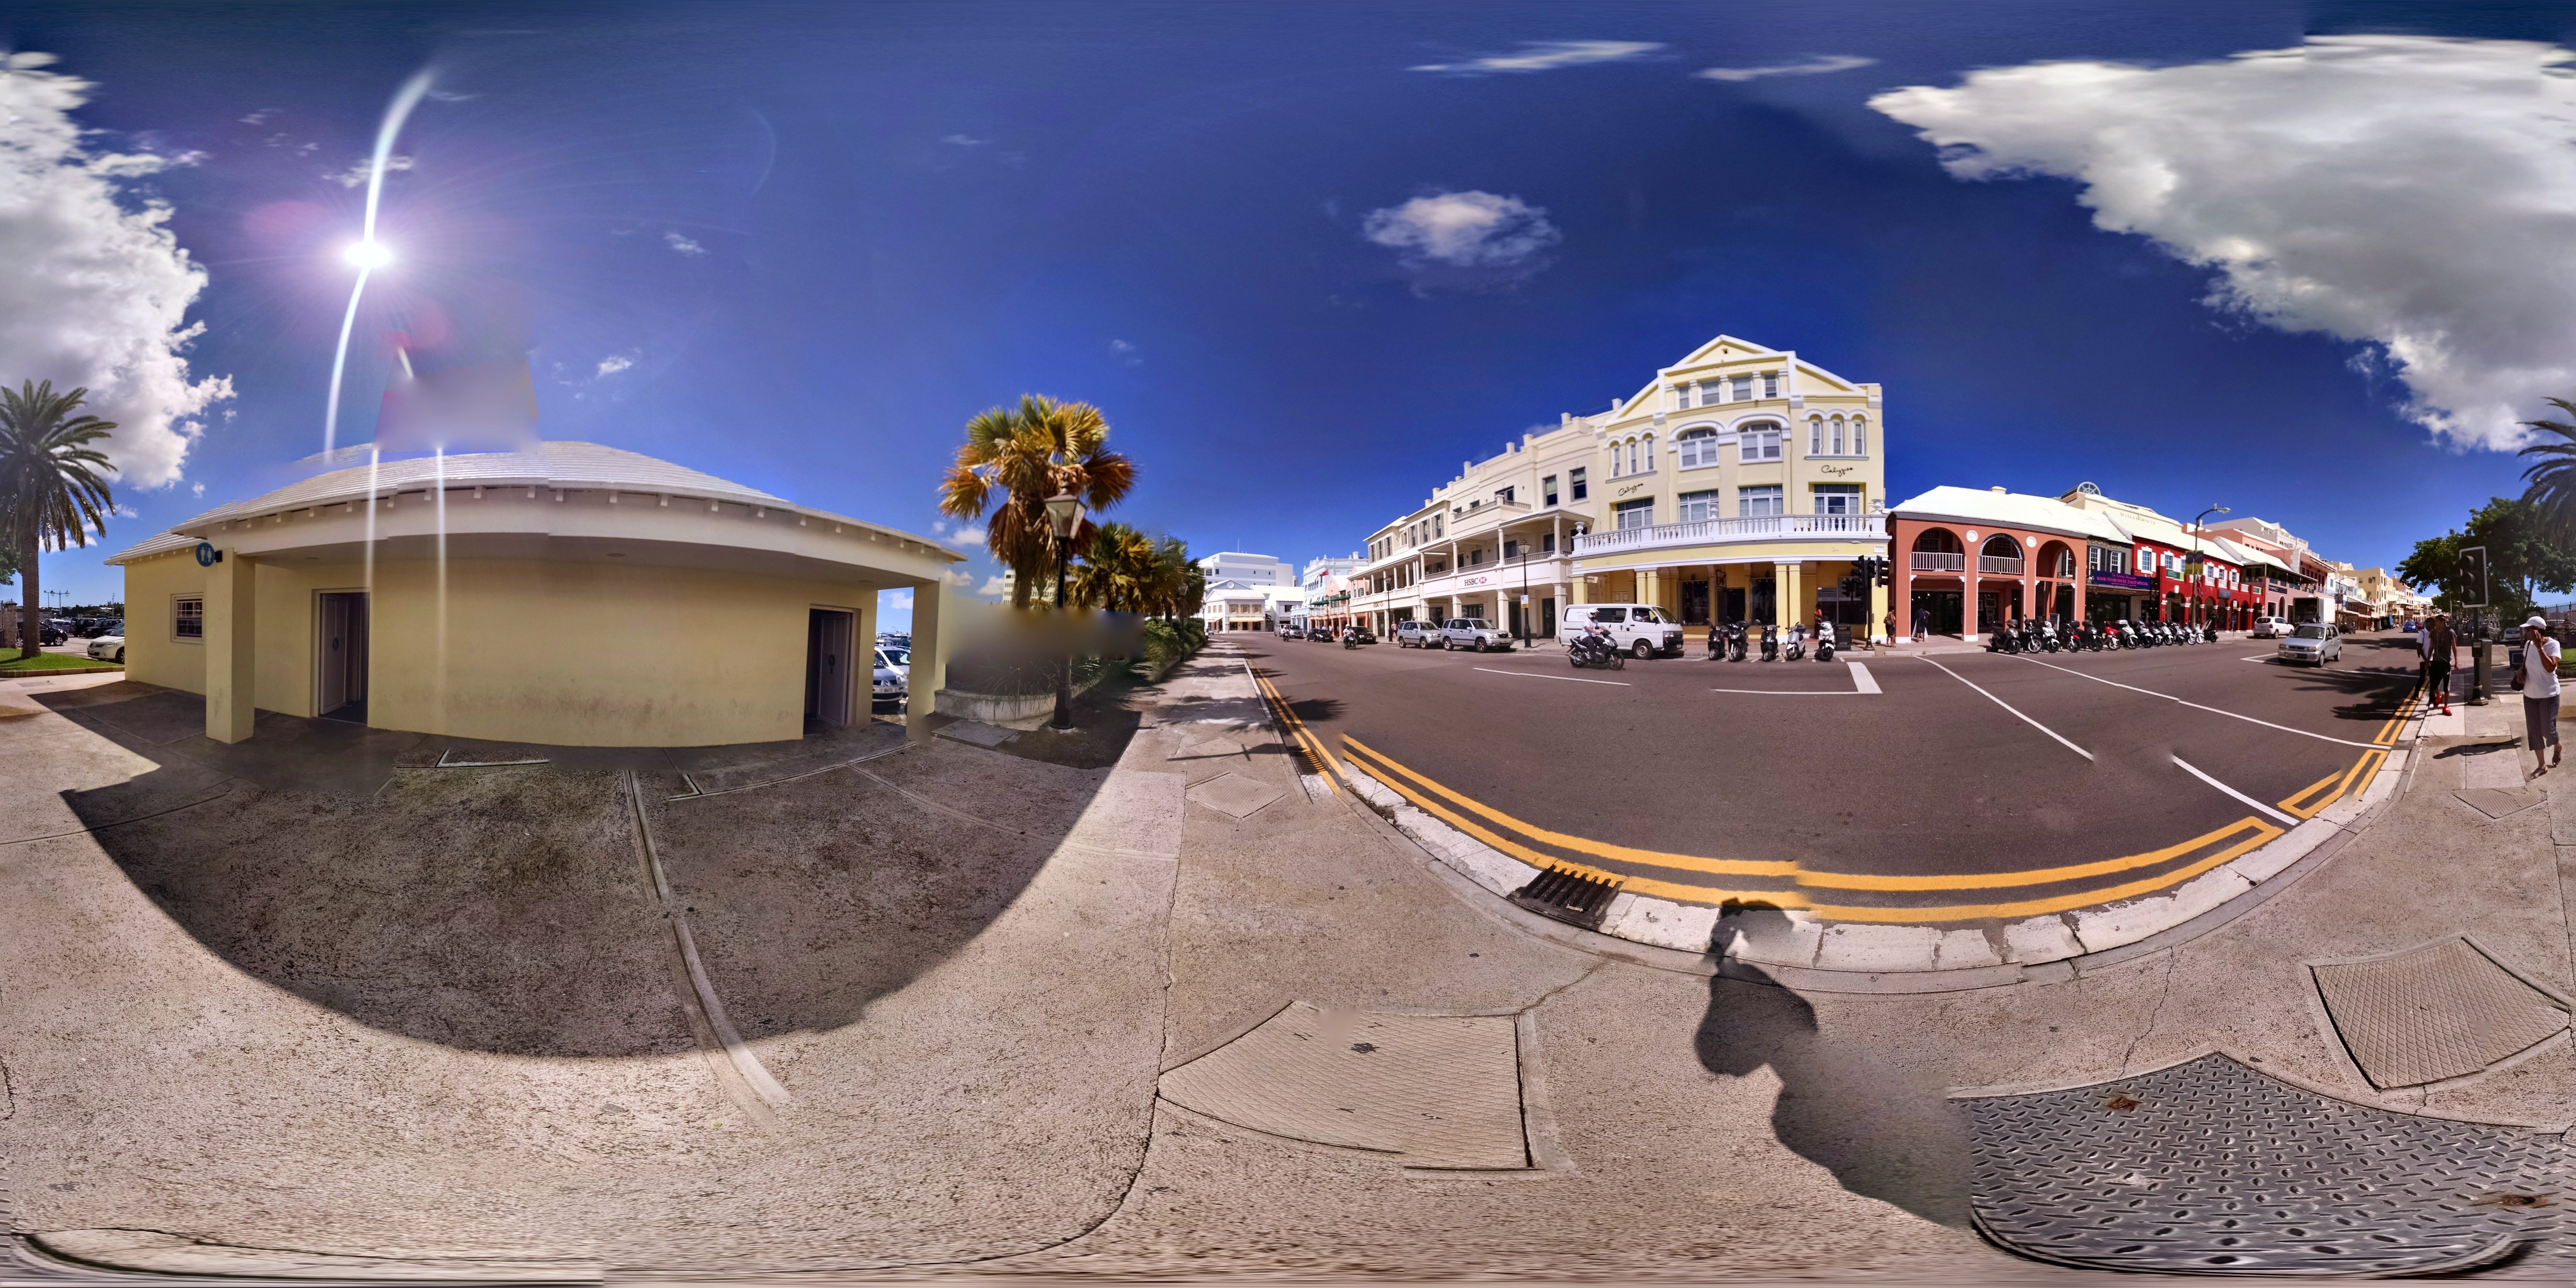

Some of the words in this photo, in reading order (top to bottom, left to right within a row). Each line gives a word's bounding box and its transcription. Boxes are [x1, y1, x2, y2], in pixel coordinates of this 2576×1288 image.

[1821, 465, 1853, 477] Calypso
[1618, 483, 1644, 496] Calypso
[1464, 578, 1478, 586] HSBC
